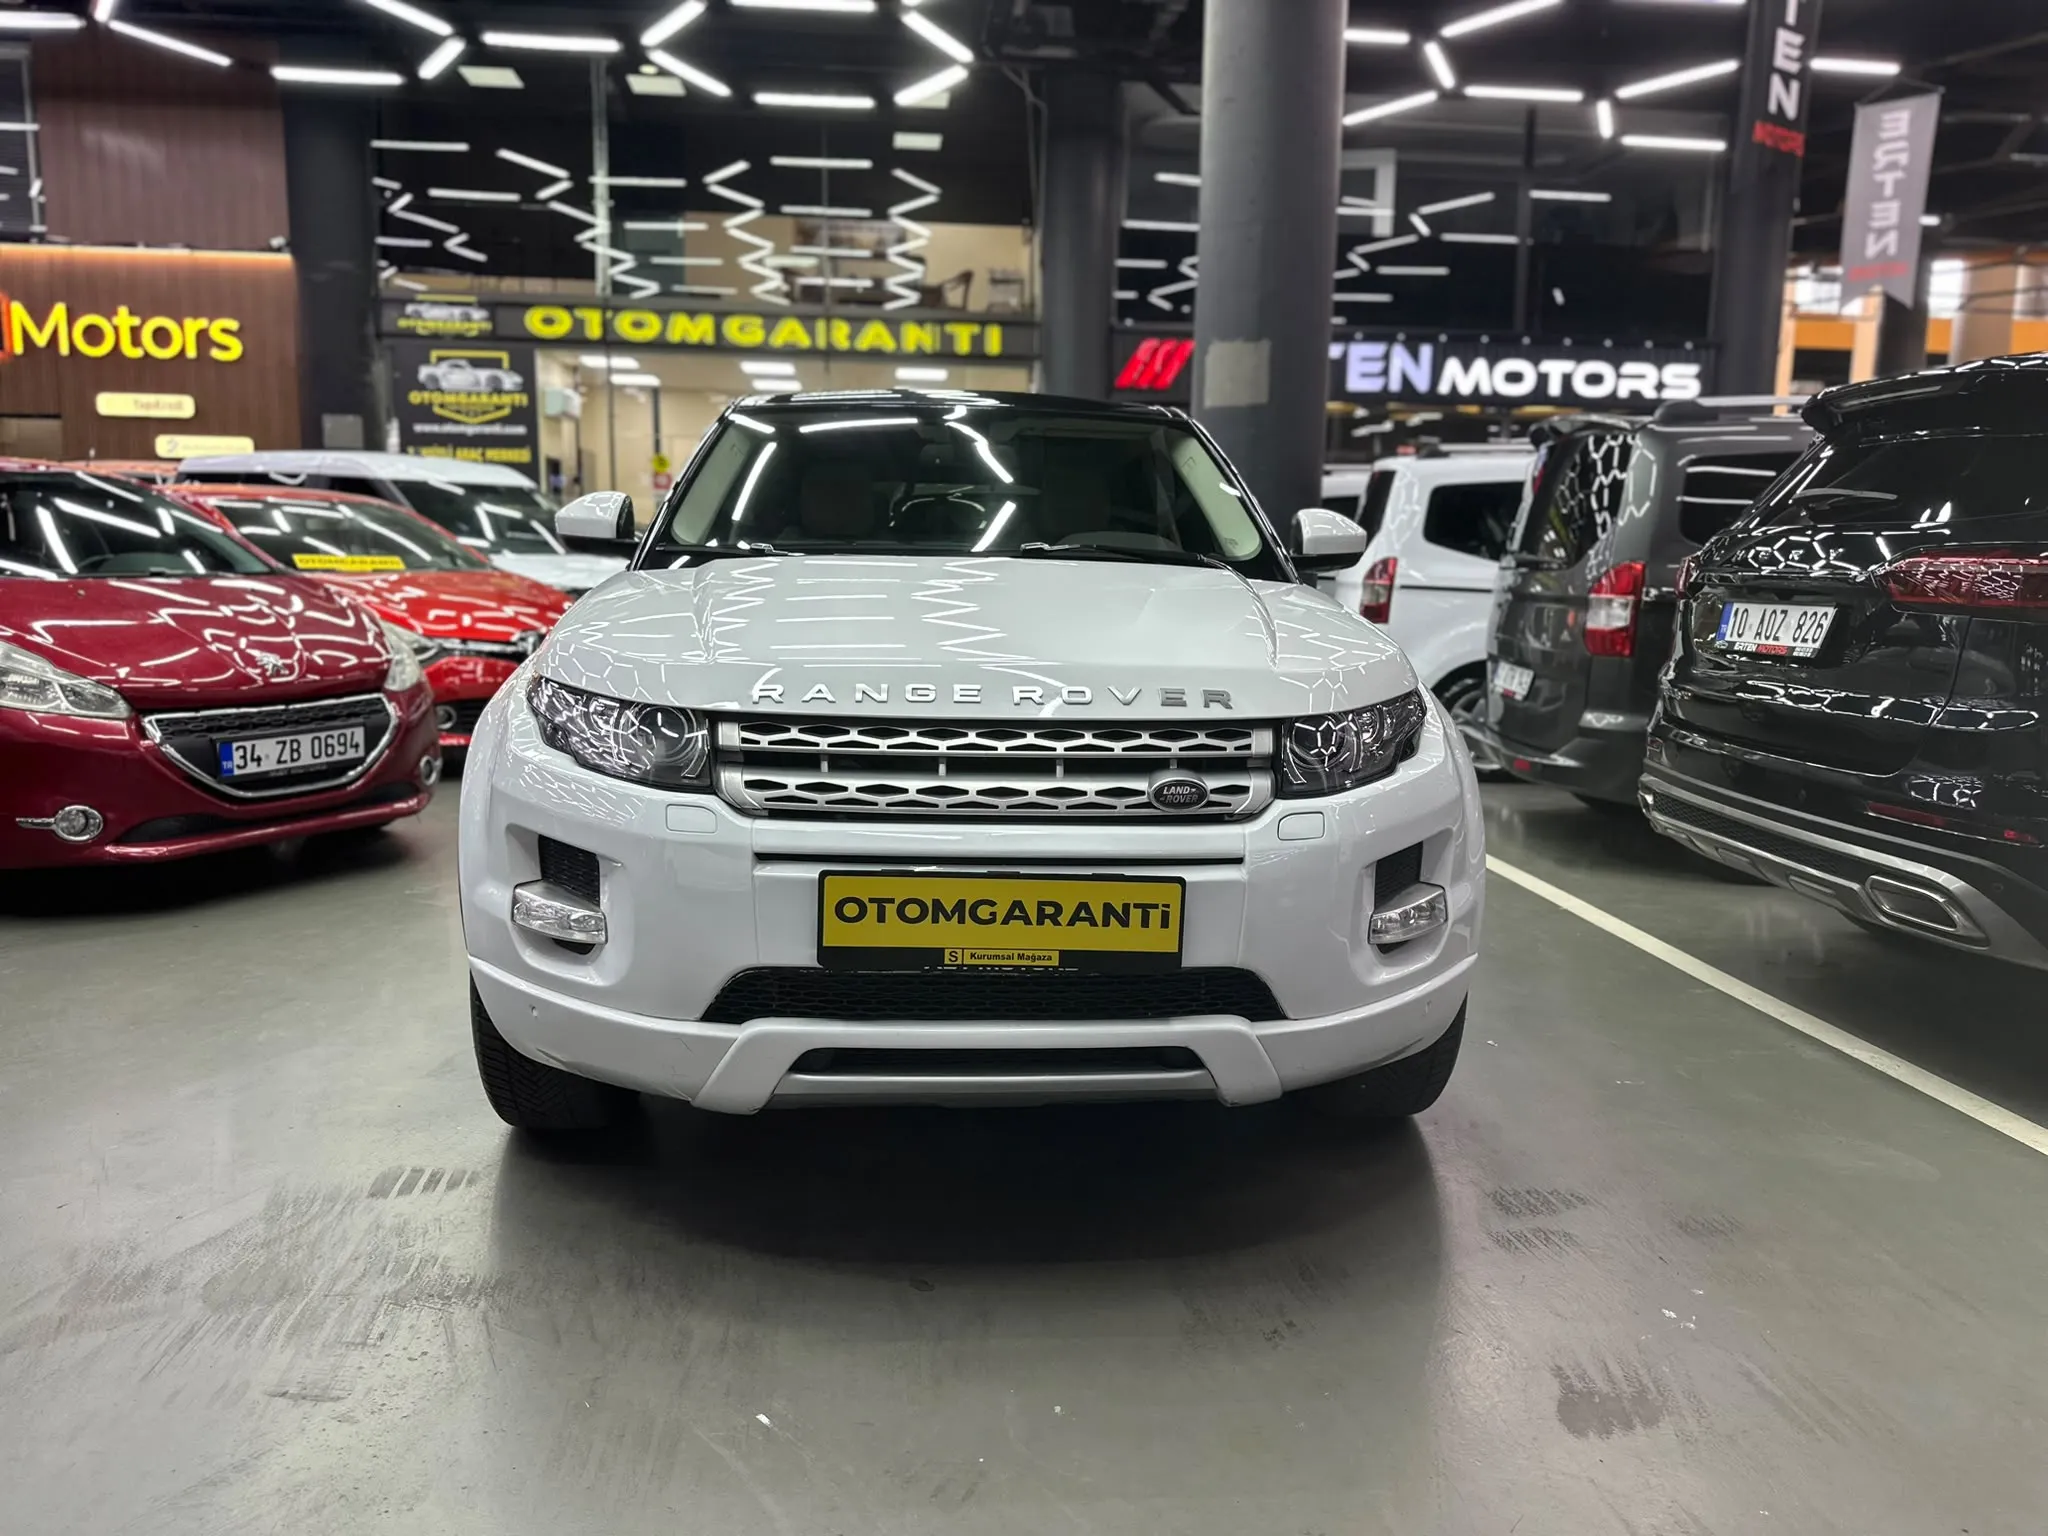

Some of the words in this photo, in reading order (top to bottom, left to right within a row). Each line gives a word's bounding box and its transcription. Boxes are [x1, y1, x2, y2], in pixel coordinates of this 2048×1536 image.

[9, 299, 244, 362] Motors
[523, 305, 1004, 356] OTOMGARANTI
[1328, 342, 1434, 394] EN
[1437, 357, 1702, 399] MOTORS
[1730, 607, 1749, 638] 10
[1792, 611, 1828, 643] 826
[1733, 641, 1757, 652] ERTEN
[751, 683, 983, 704] RANGE
[1012, 686, 1233, 709] ROVER
[235, 743, 262, 769] 34
[276, 739, 301, 764] ZB
[311, 731, 360, 759] 0694
[1163, 786, 1190, 795] LAND
[1165, 794, 1198, 804] ROVER
[948, 951, 959, 963] S
[970, 952, 1014, 962] Kurumsal
[1017, 953, 1053, 963] Mağaza
